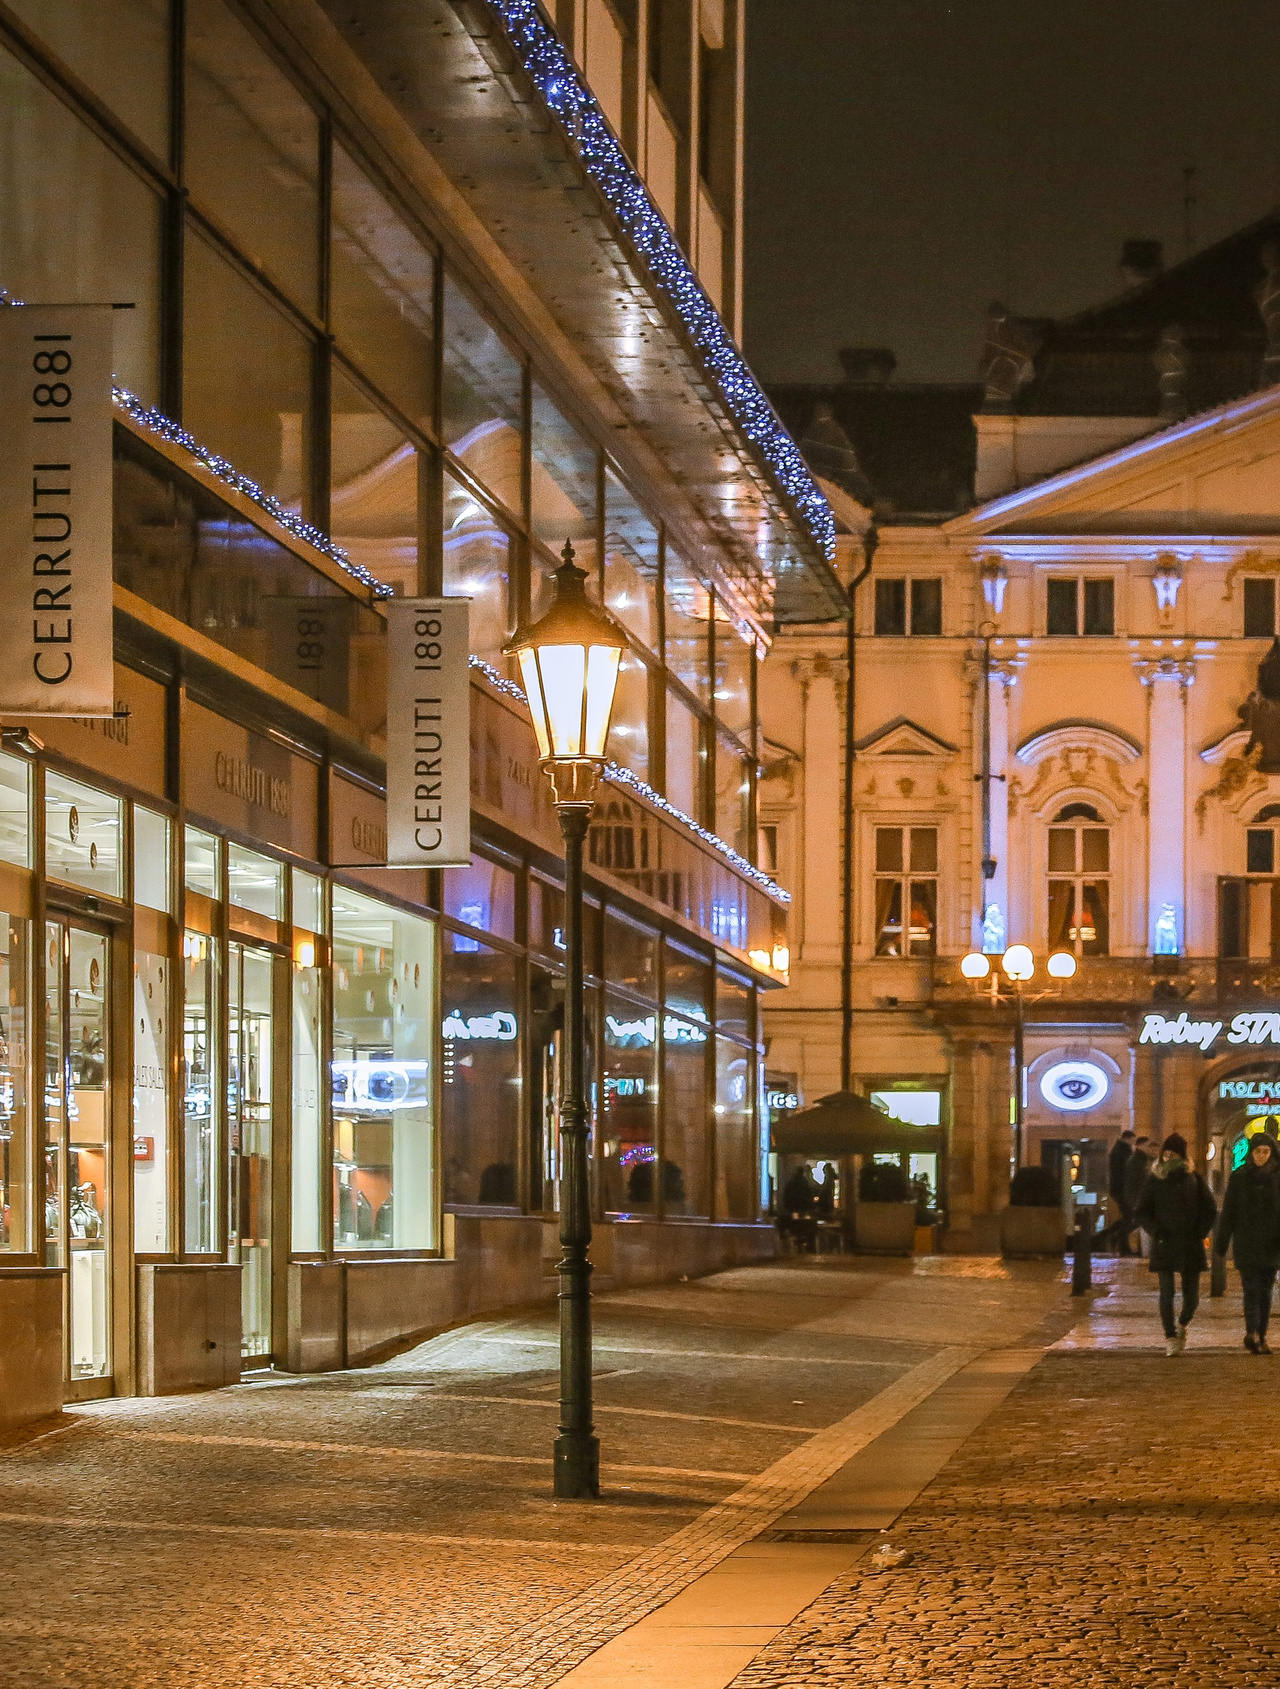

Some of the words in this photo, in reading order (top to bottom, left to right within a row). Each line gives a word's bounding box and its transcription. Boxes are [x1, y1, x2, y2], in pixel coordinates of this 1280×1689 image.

[33, 334, 72, 423] 1881
[33, 463, 72, 685] CERRUTI
[414, 608, 442, 671] 1881
[414, 698, 442, 851] CERRUTI
[1139, 1012, 1222, 1050] Rebuy
